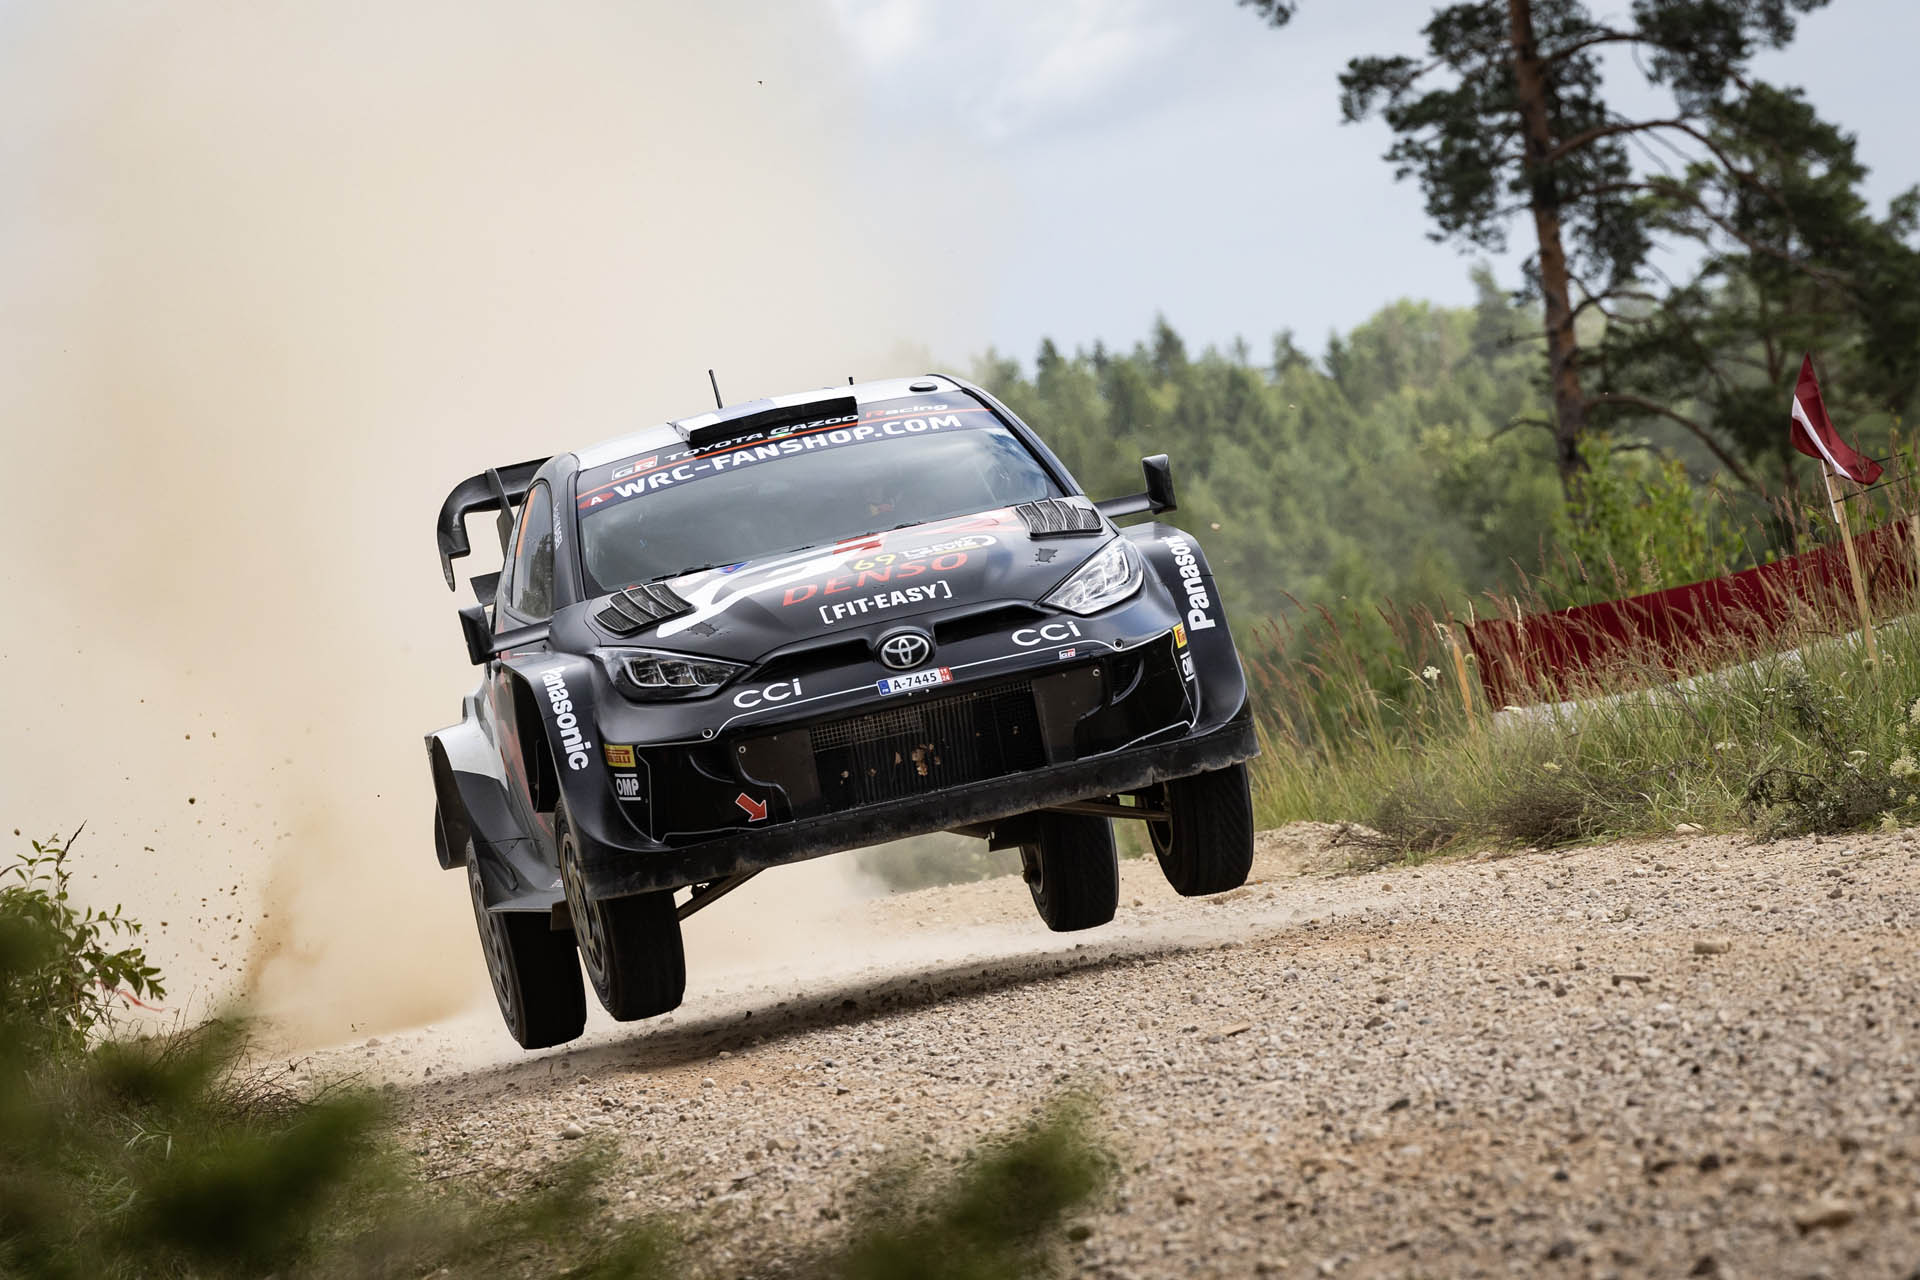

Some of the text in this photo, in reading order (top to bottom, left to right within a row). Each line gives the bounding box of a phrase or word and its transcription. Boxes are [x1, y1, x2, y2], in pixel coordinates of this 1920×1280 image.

[664, 432, 762, 461] TOYOTA
[769, 415, 858, 436] GAZOO
[865, 404, 948, 418] Racing
[613, 415, 962, 497] WRC-FANSHOP.COM
[782, 552, 968, 607] DENSO
[853, 554, 896, 571] 69
[893, 672, 937, 690] A-7445
[616, 778, 639, 796] OMP
